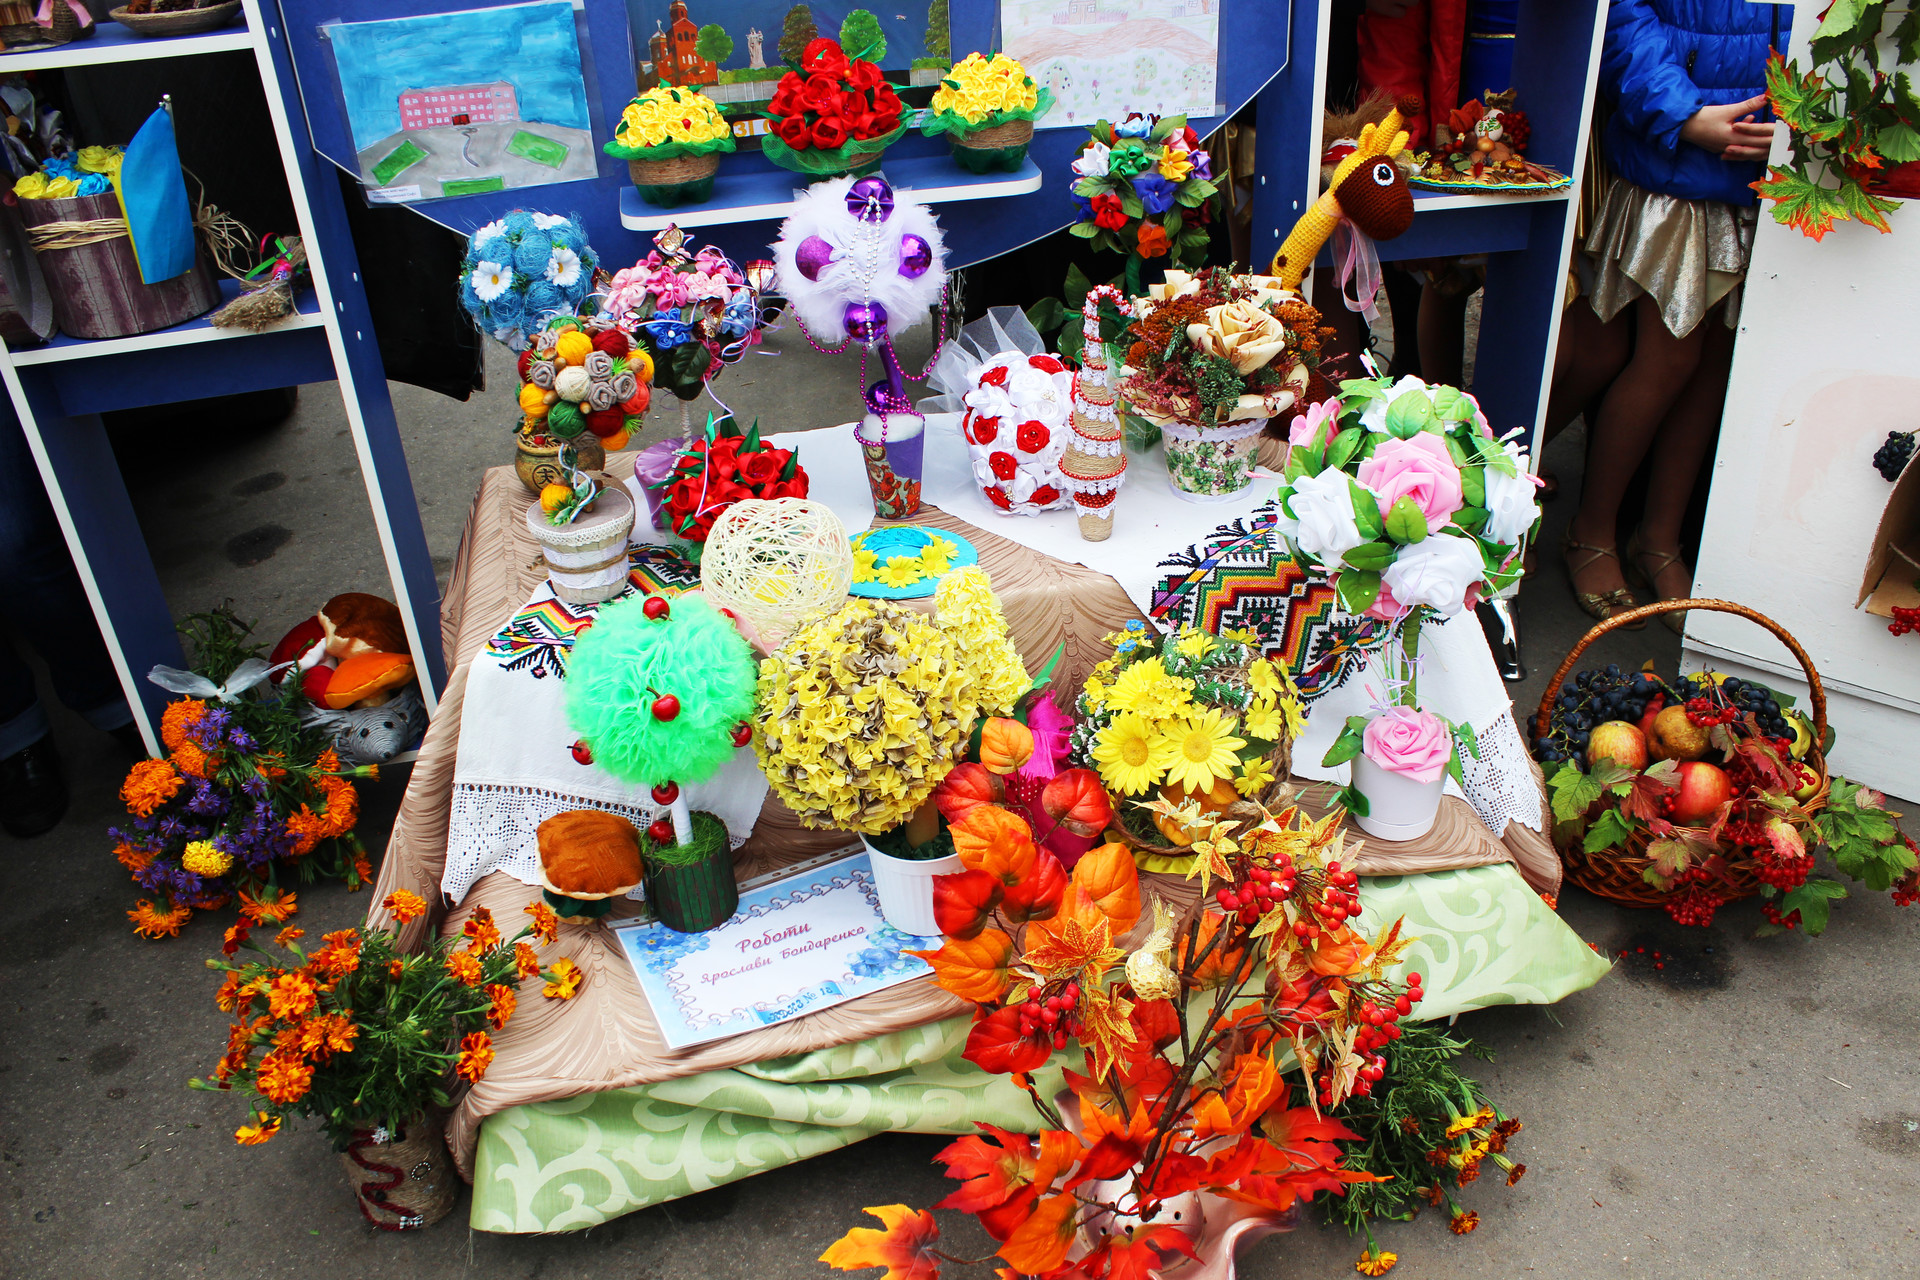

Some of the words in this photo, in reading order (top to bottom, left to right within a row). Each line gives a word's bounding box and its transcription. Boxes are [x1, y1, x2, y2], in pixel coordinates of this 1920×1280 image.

[700, 956, 773, 986] Ярослави
[779, 925, 867, 959] Бондаренко
[736, 923, 812, 953] Роботи
